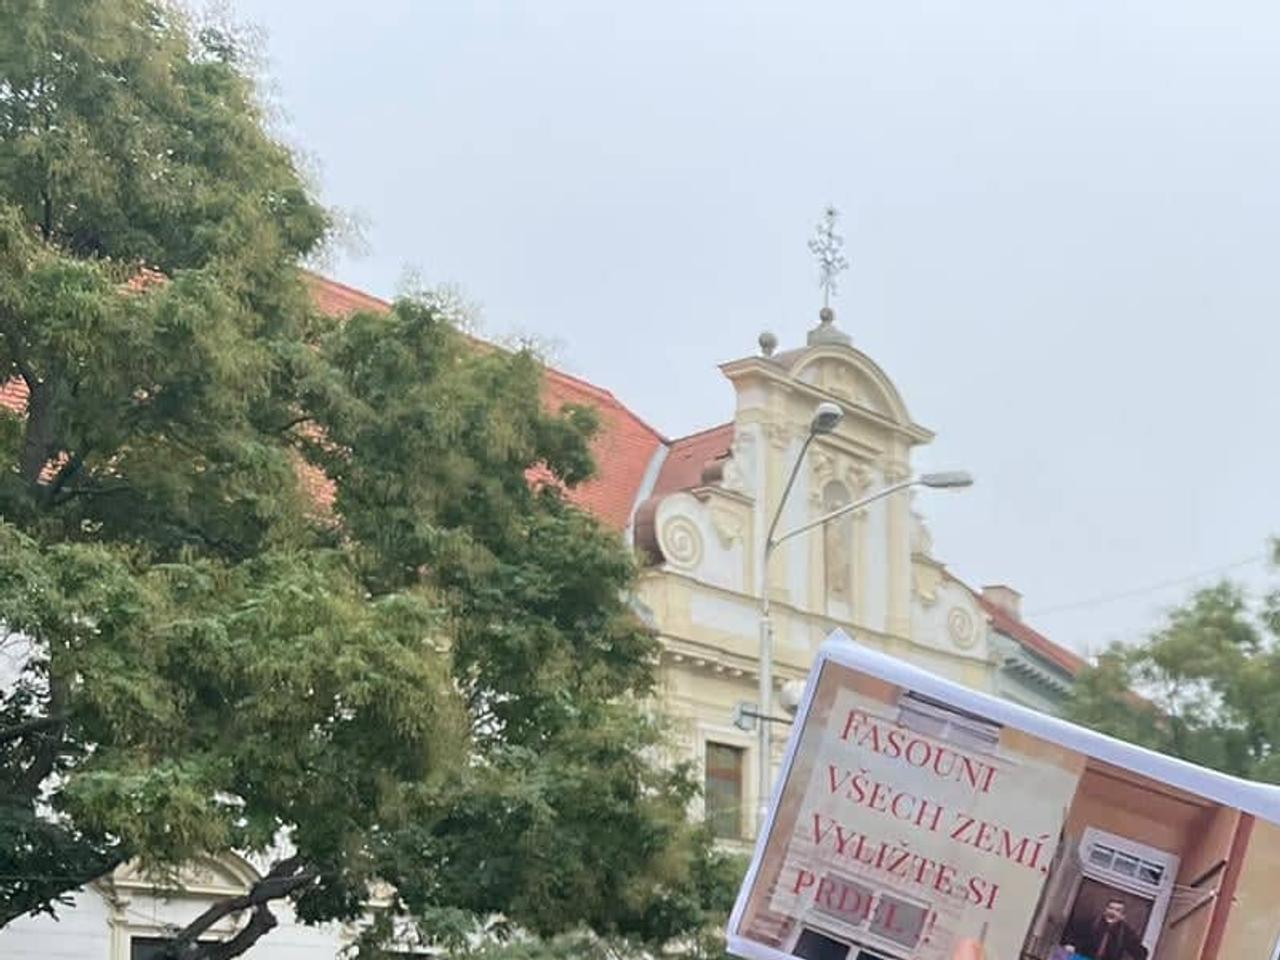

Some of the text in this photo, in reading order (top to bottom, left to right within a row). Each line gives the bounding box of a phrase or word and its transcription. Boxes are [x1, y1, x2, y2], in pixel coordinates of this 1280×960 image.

[841, 708, 998, 794] FAŠOUNI
[827, 764, 944, 832] VŠECH
[813, 813, 1001, 910] VYLIŽTE SI
